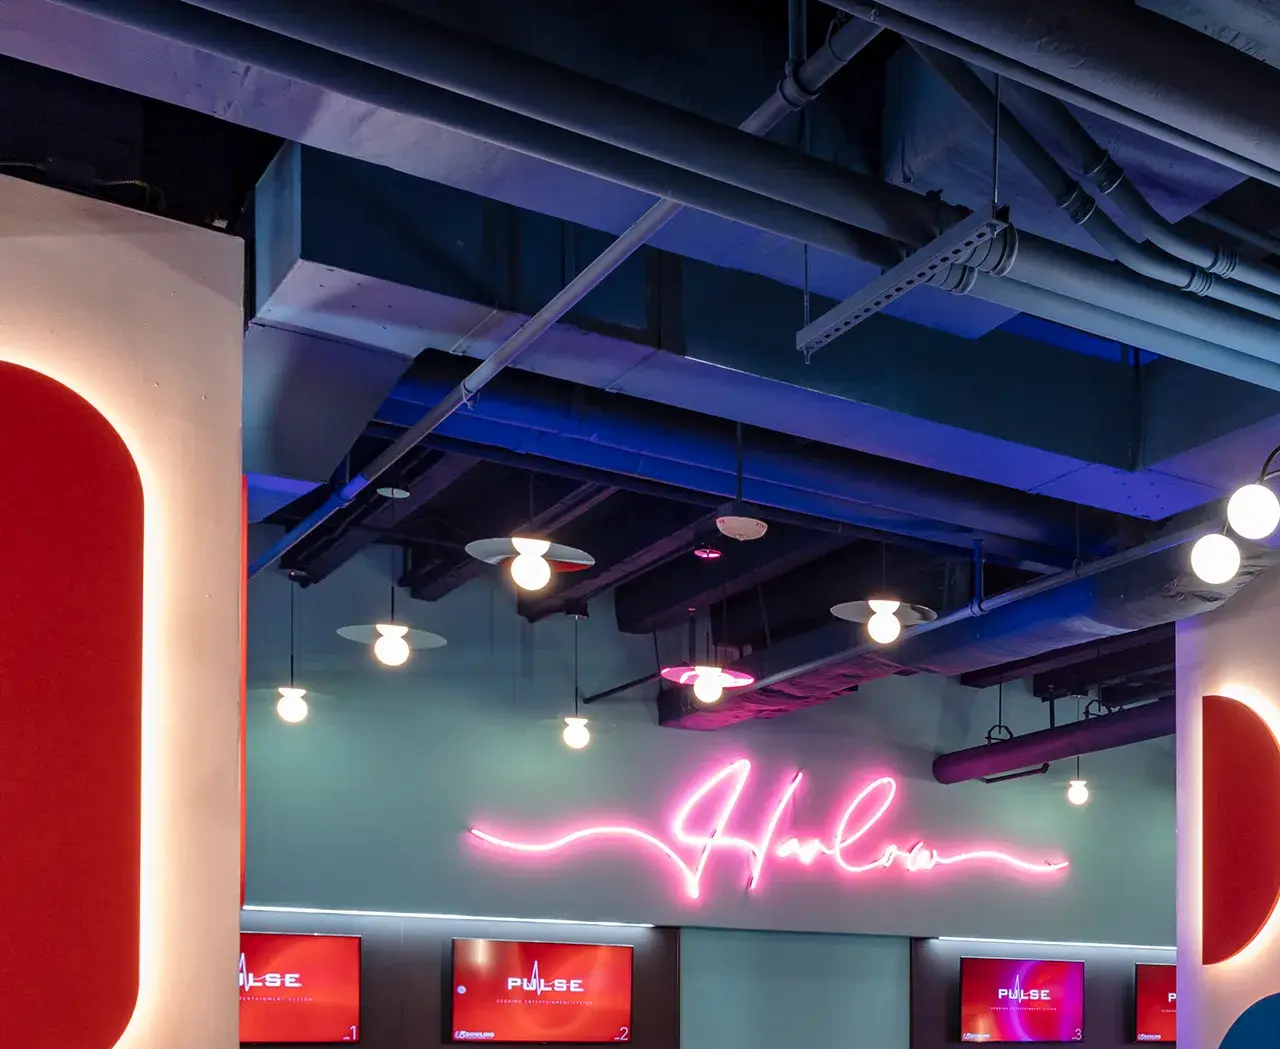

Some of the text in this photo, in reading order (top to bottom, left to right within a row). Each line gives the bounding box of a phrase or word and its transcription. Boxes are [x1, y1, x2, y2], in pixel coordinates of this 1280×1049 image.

[507, 976, 585, 992] PULSE
[998, 988, 1052, 1001] PULSE
[349, 1025, 357, 1040] 1
[619, 1026, 629, 1041] 2
[1074, 1028, 1082, 1041] 3
